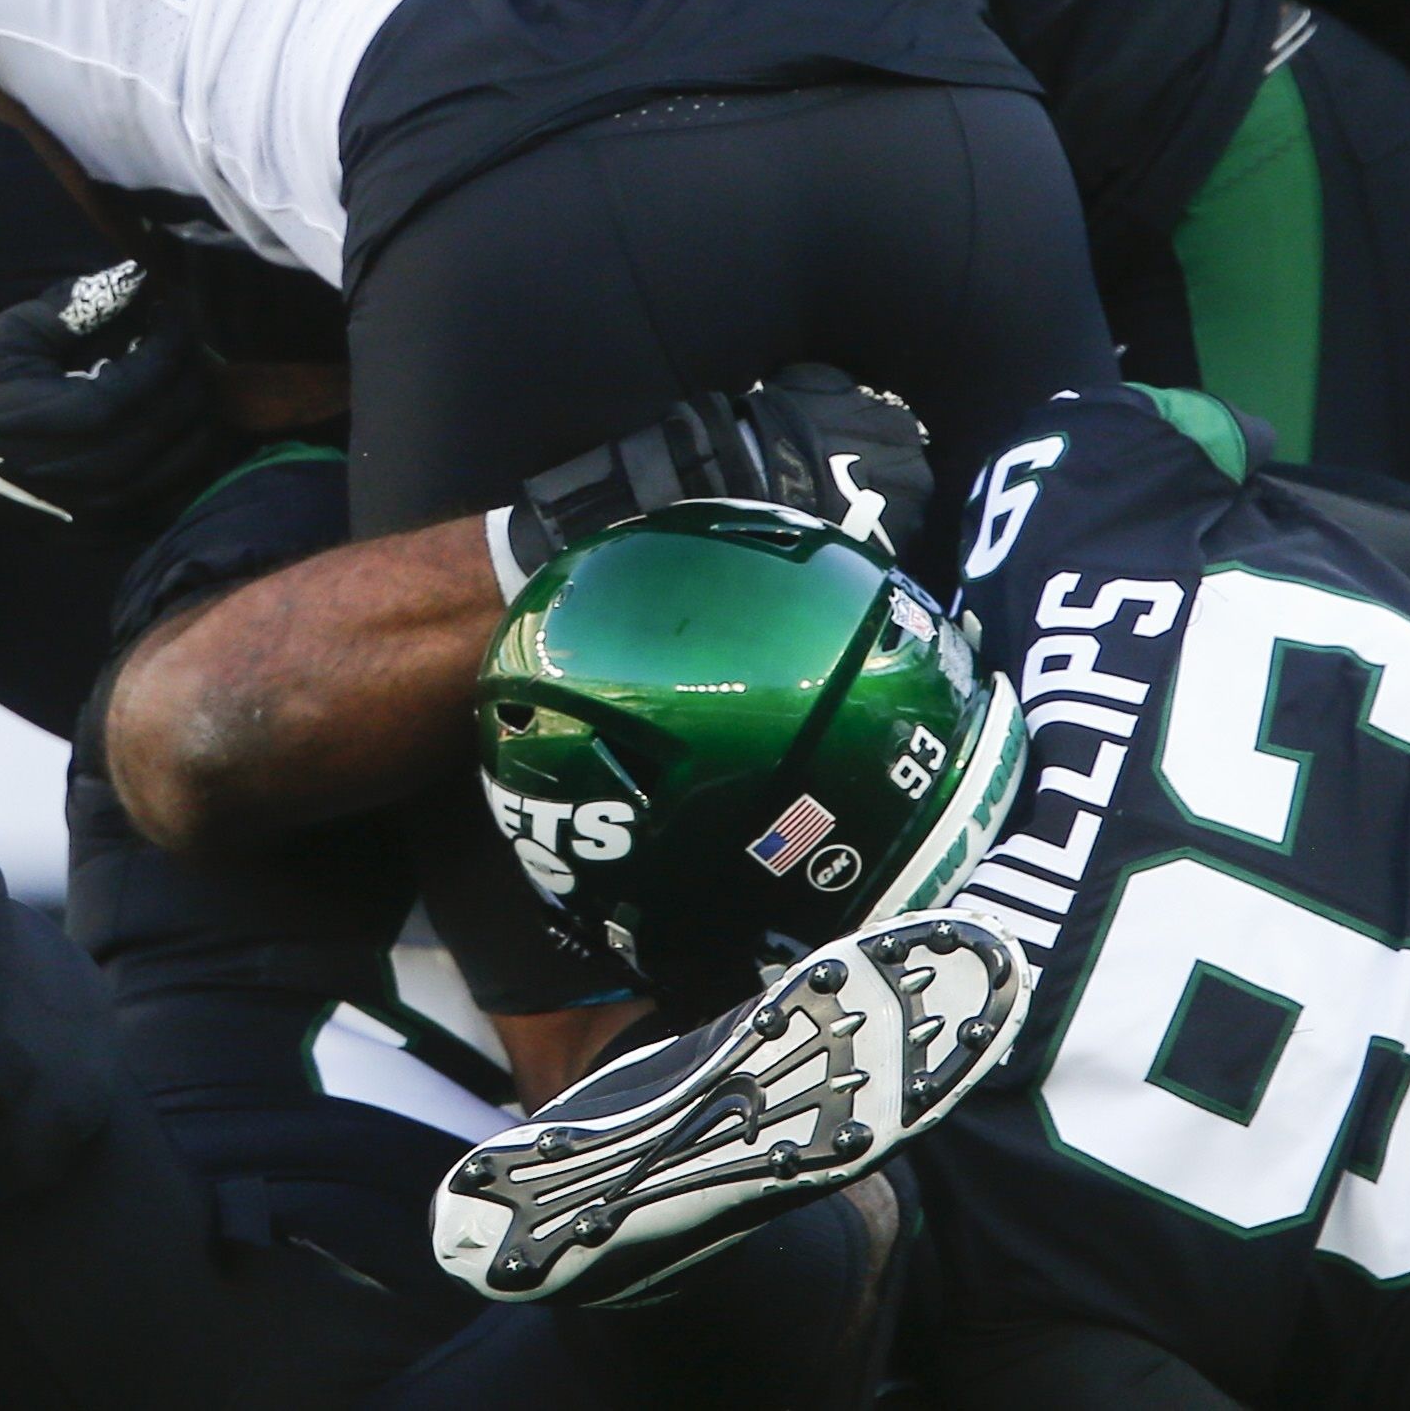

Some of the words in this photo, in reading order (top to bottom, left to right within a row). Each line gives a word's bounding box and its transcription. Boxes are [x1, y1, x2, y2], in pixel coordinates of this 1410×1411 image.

[890, 724, 948, 800] 93
[480, 765, 635, 861] ETS
[895, 826, 968, 917] EW
